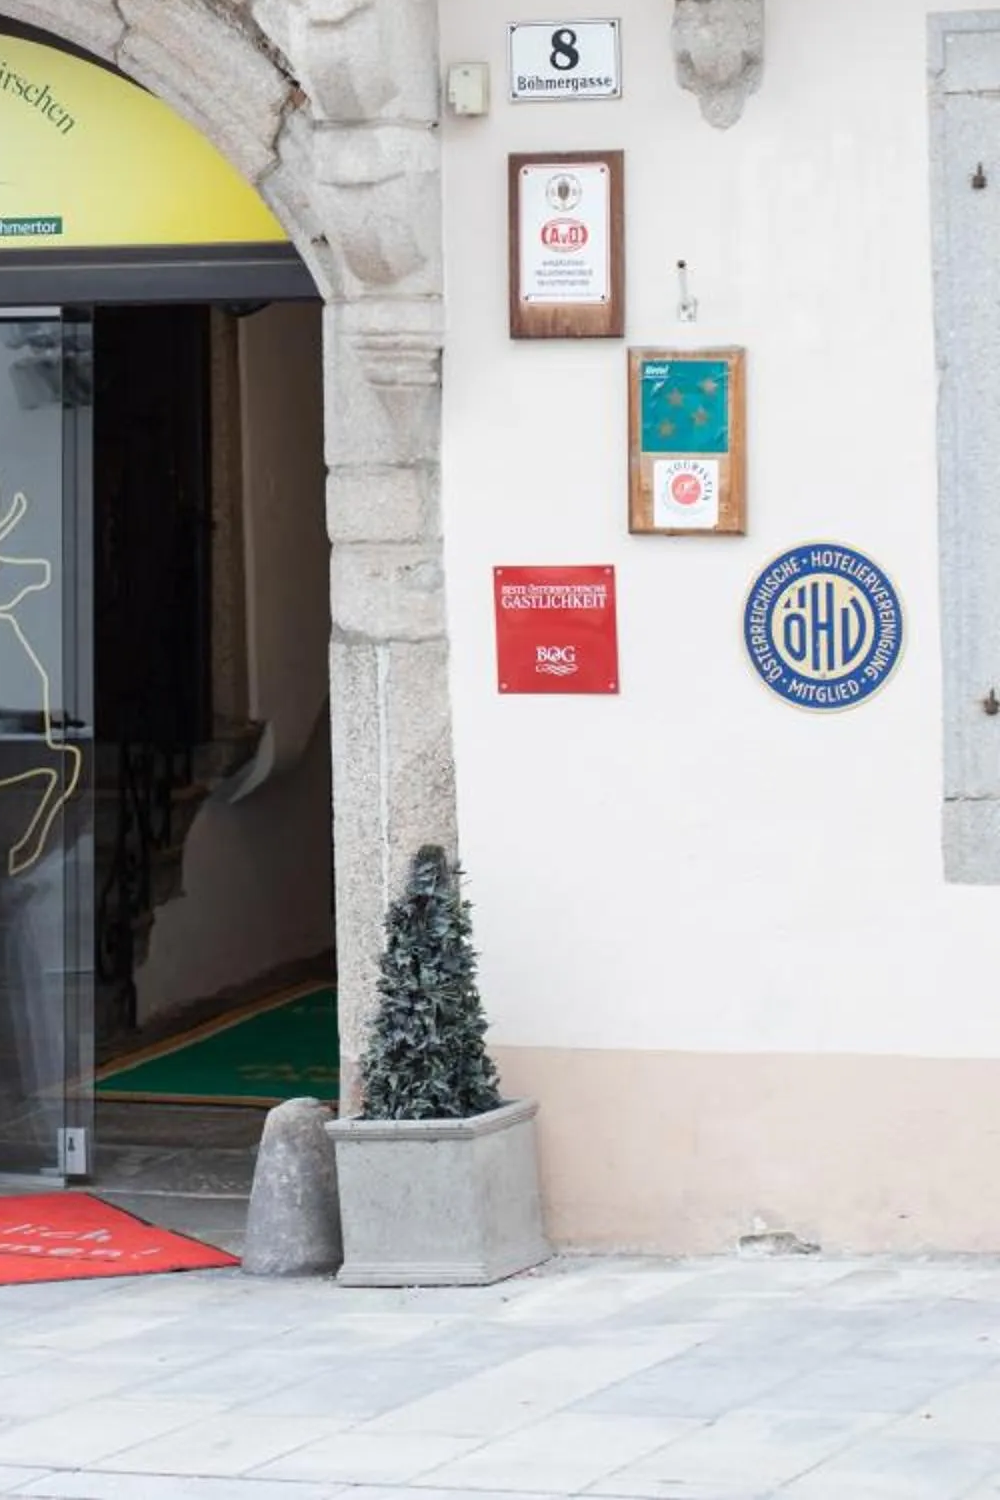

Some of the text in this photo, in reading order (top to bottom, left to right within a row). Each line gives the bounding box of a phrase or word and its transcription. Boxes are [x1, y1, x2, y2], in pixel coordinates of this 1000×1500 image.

[549, 27, 580, 72] 8
[516, 74, 613, 92] Böhmergasse
[502, 594, 608, 609] GASTLICHKEIT
[750, 551, 897, 684] ÖSTERREICHISCHE HOTELIERVEREINIGUNG
[783, 581, 867, 671] ÖHV
[787, 678, 860, 703] MITGLIED
